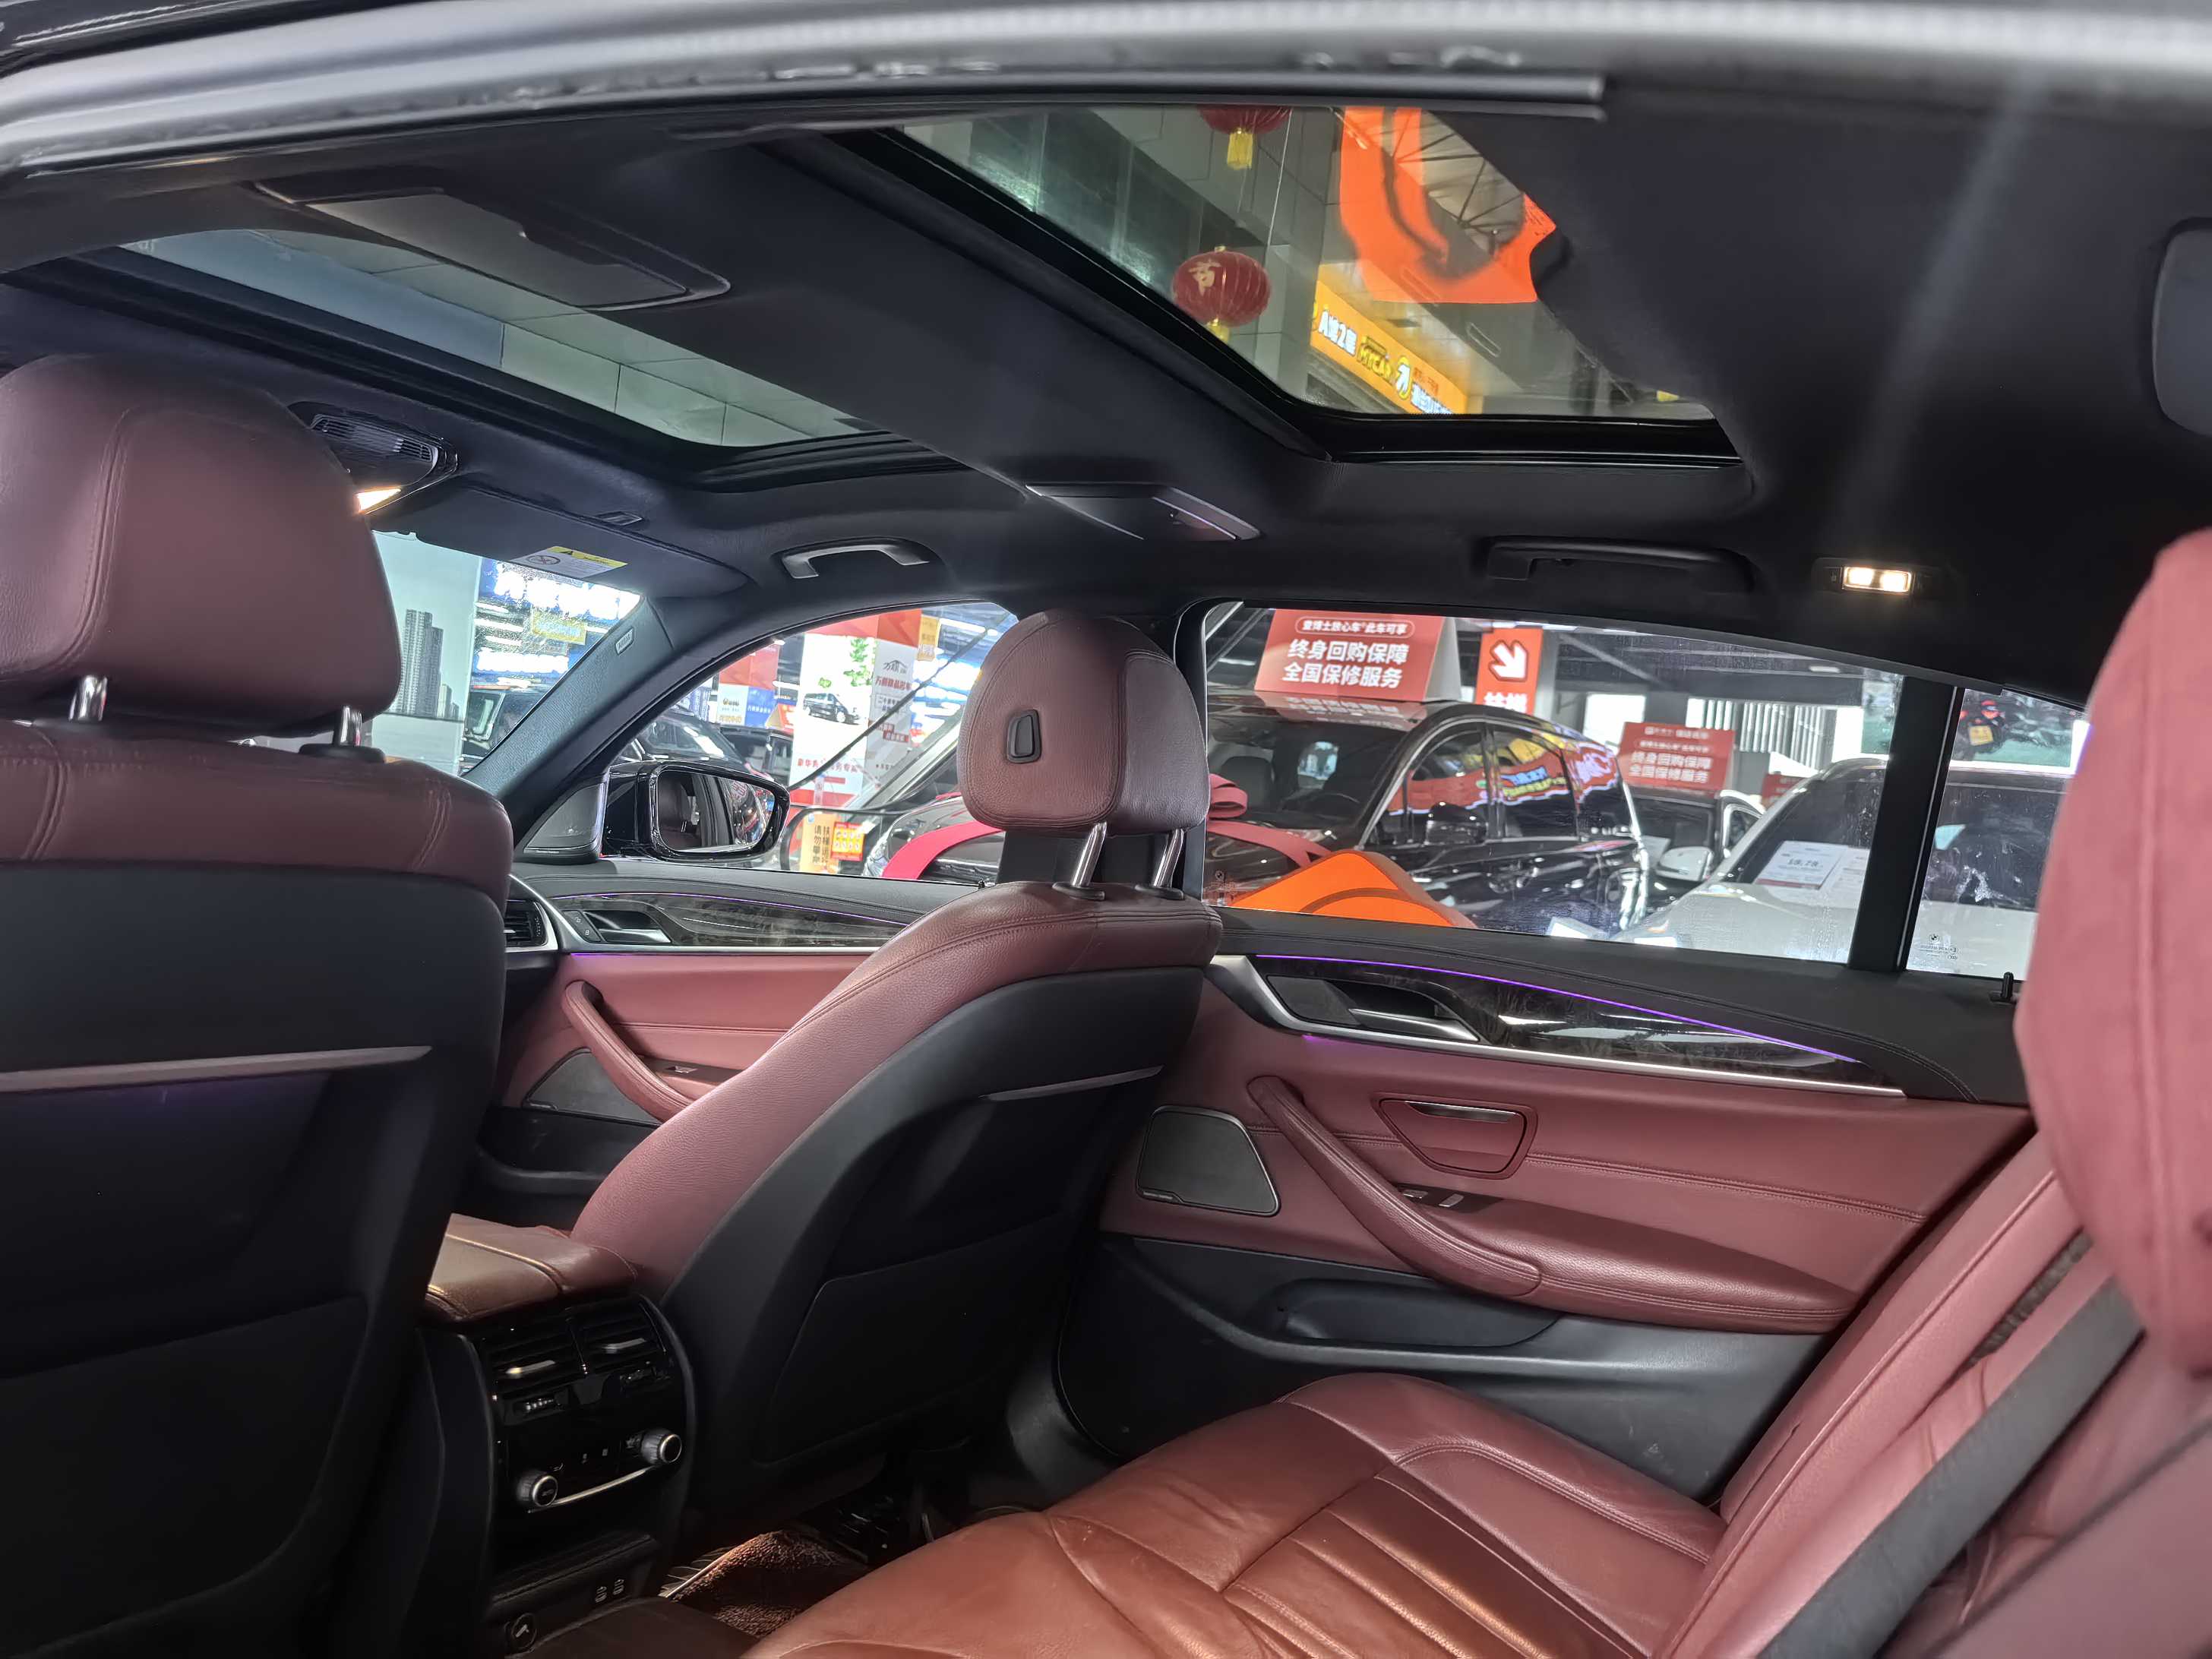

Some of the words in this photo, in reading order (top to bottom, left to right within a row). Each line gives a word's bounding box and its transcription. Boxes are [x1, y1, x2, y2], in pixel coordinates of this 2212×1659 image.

[1287, 639, 1410, 665] 终身回购保障
[1282, 662, 1402, 688] 全国保修服务
